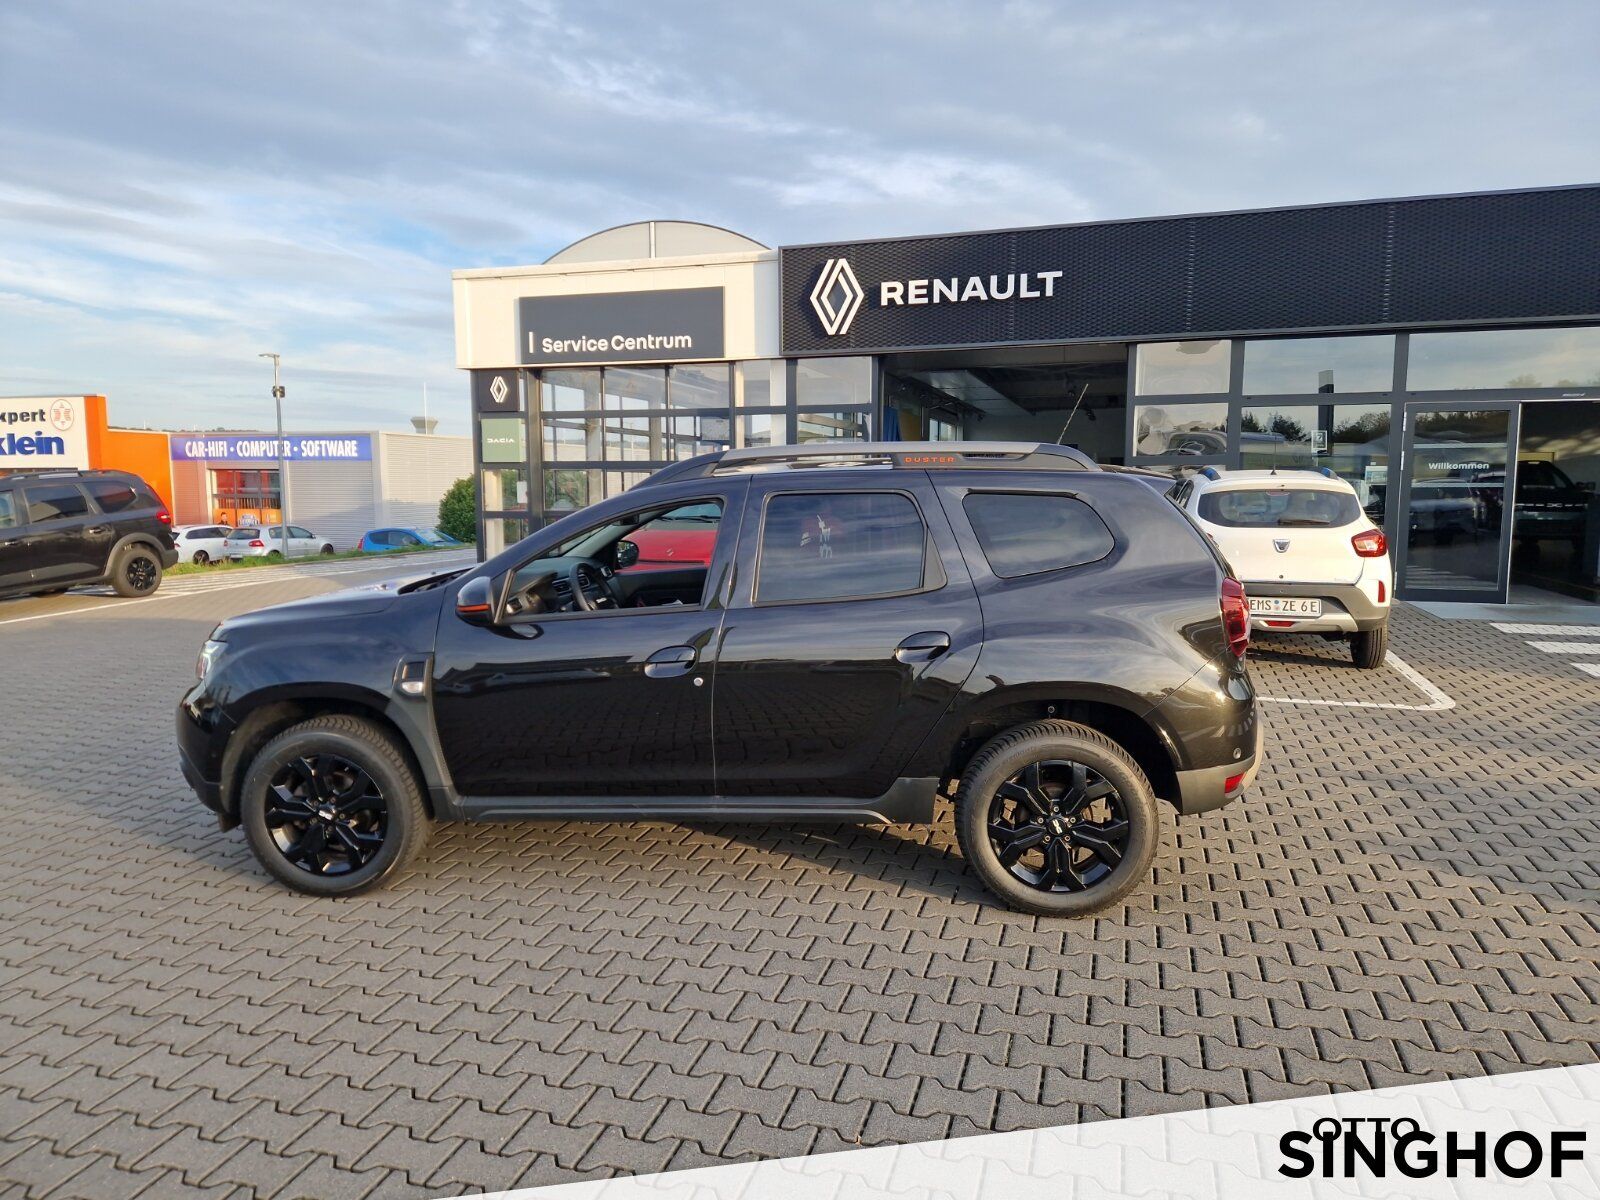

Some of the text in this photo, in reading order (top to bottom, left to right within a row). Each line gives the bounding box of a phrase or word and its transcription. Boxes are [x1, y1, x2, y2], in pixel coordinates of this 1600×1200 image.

[880, 271, 1063, 306] RENAULT
[542, 334, 692, 353] Service Centrum
[185, 440, 228, 458] CAR-HIFI
[301, 440, 358, 457] SOFTWARE
[1428, 462, 1490, 470] Willkommen
[1250, 600, 1272, 611] EMS
[1282, 600, 1296, 612] ZE
